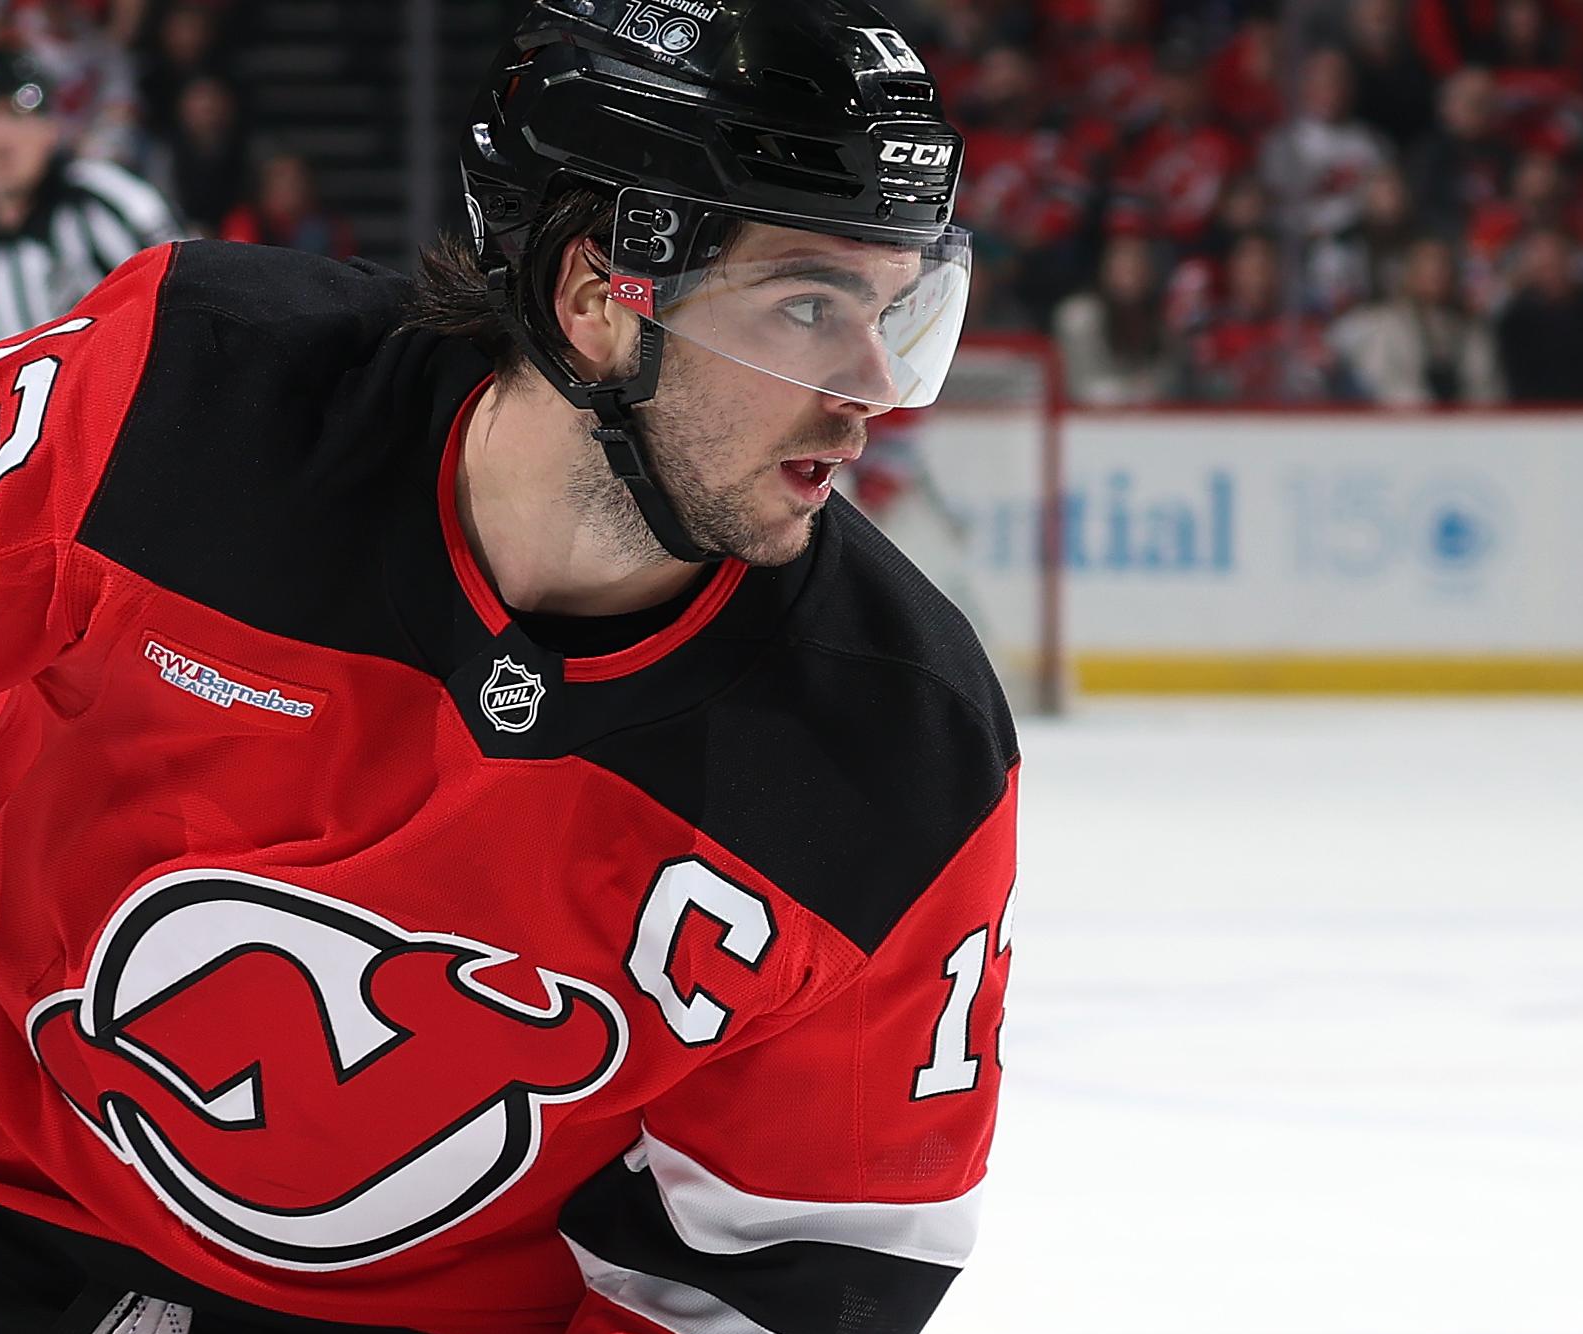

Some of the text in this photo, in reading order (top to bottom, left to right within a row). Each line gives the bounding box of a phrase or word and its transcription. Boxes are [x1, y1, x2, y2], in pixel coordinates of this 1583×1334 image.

[879, 139, 954, 166] CCM
[144, 641, 314, 718] RWJBarnabas
[161, 669, 231, 707] HEALTH
[491, 687, 531, 708] NHL
[625, 858, 779, 1049] C
[910, 884, 1019, 1102] 1
